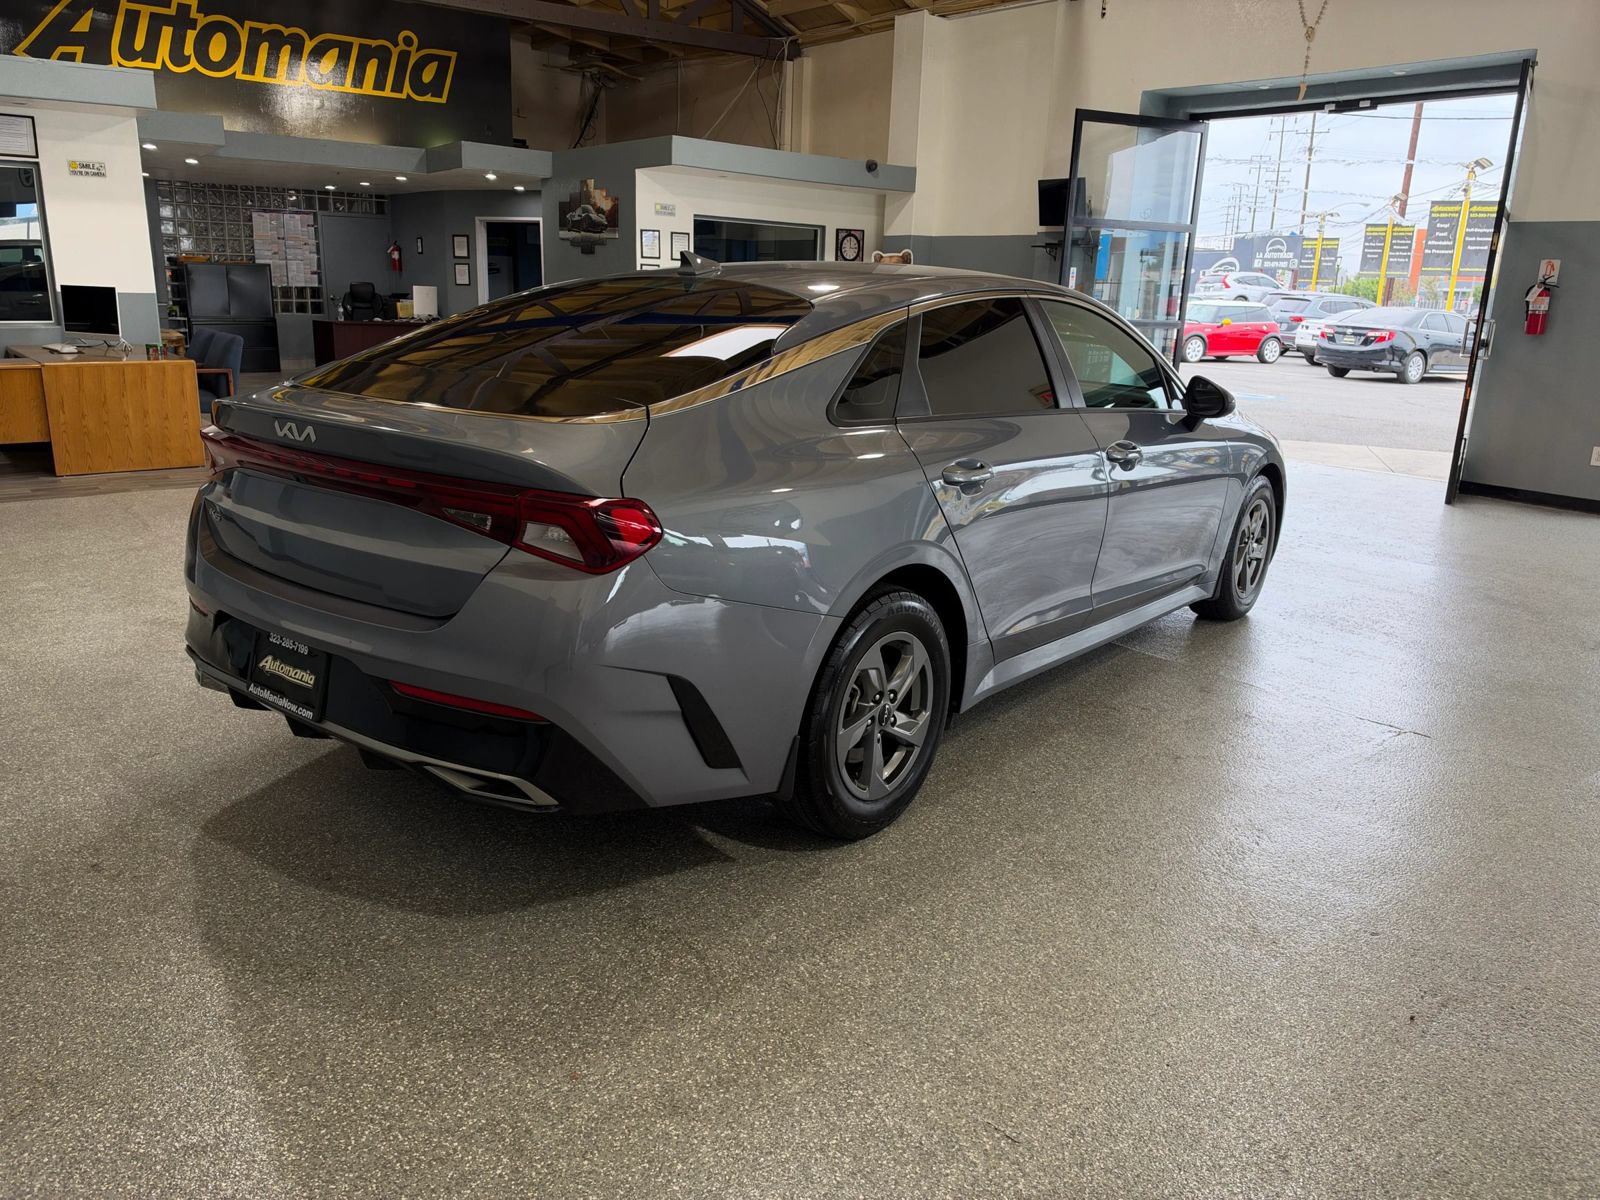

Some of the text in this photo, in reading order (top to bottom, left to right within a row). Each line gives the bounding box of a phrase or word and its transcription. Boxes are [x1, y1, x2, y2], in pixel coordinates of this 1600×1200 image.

[12, 0, 457, 103] Automania
[274, 419, 317, 444] KIA
[268, 632, 309, 655] 323-285-7199
[258, 654, 316, 686] Automania
[248, 682, 314, 719] AutoManiaNow.com
